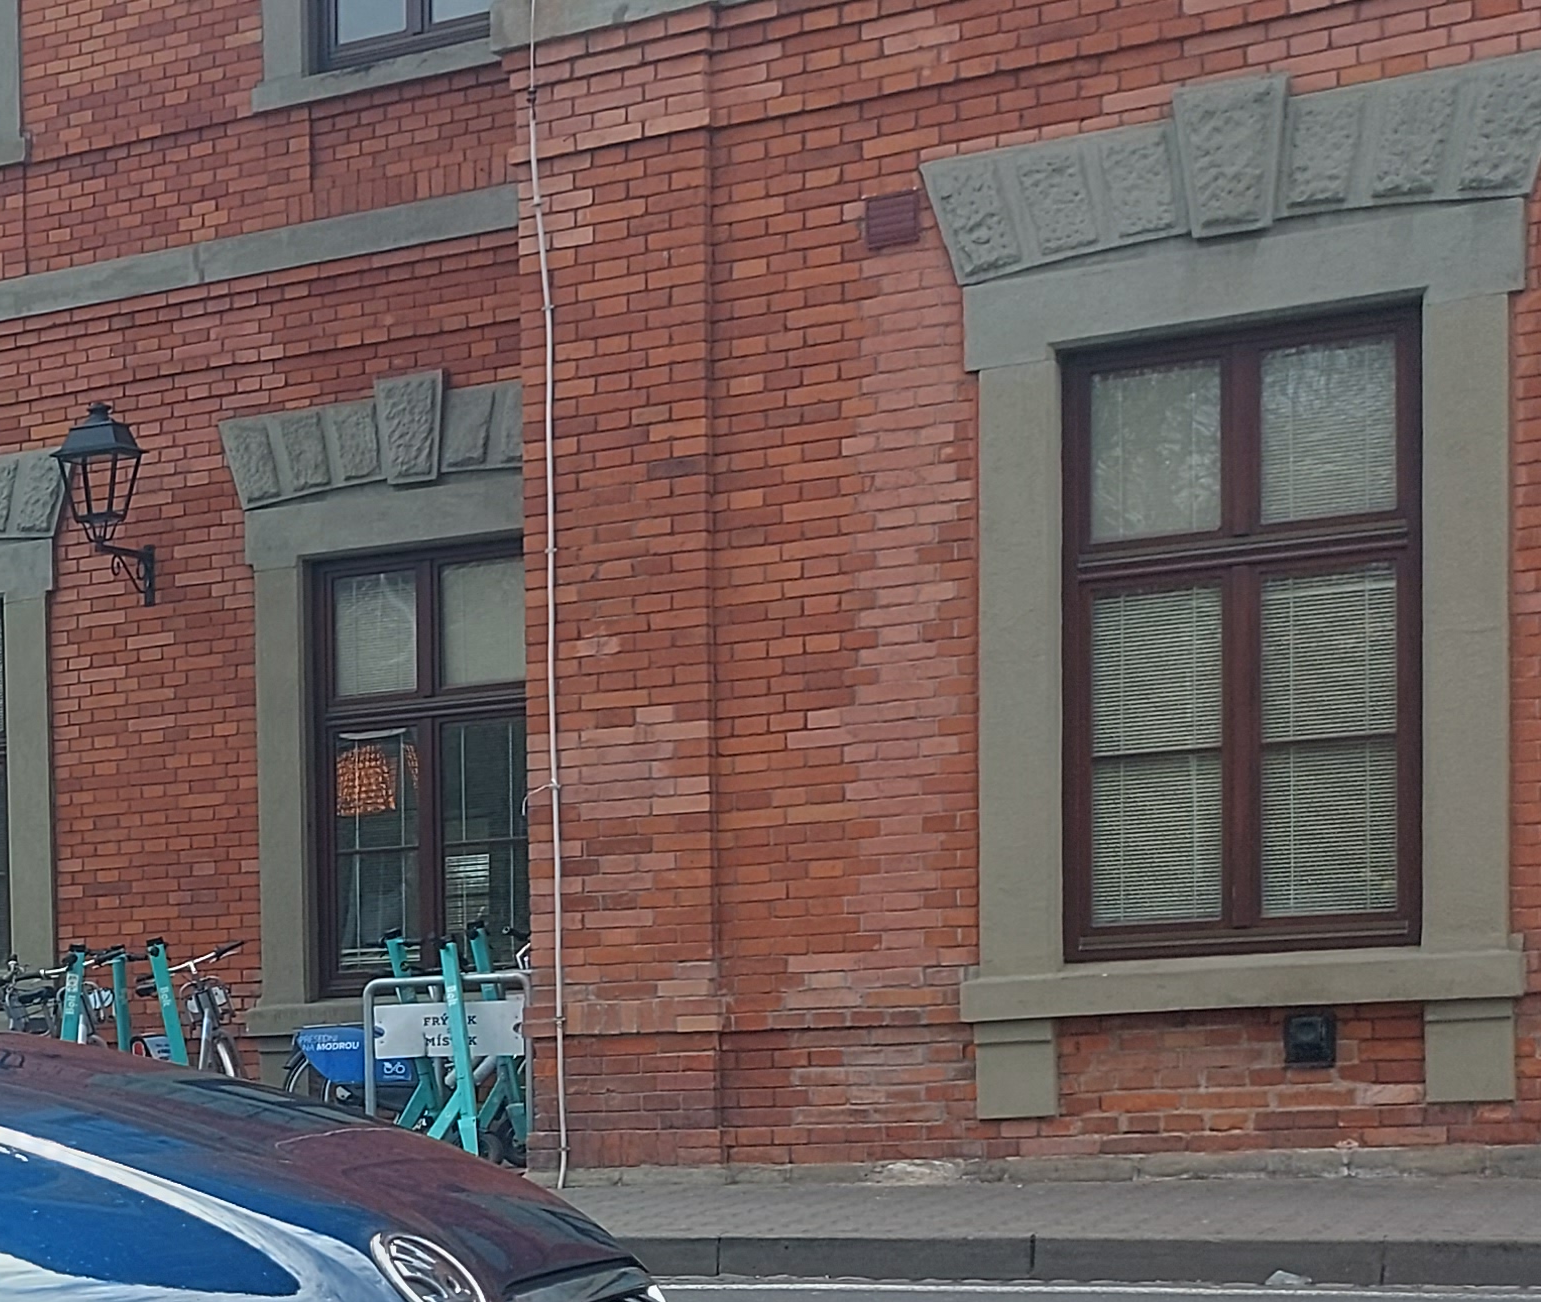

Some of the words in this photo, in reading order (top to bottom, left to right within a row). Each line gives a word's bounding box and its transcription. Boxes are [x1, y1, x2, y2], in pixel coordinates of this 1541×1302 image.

[423, 1012, 477, 1027] FRÝK
[316, 1041, 360, 1052] MODROU
[424, 1033, 477, 1047] MÍSK
